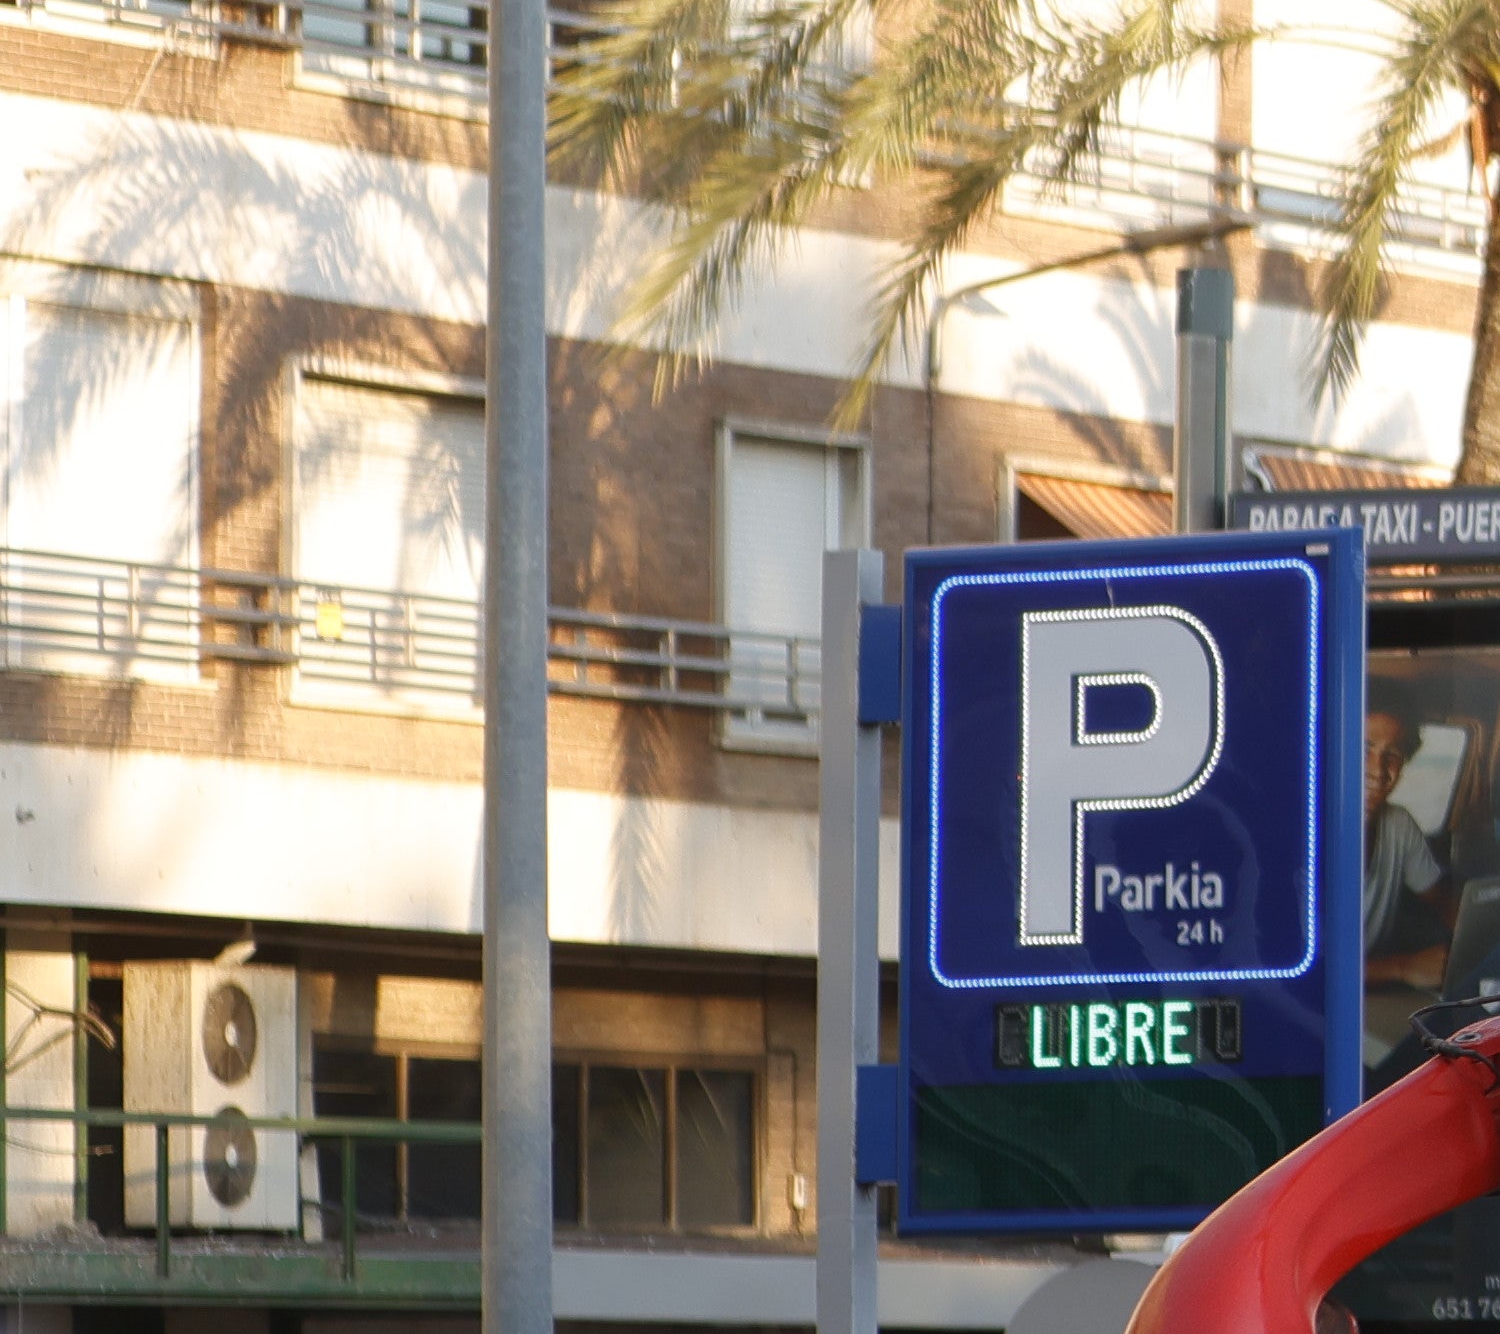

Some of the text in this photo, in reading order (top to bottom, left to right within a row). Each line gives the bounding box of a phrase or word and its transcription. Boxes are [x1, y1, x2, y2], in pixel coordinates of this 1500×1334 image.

[1361, 503, 1417, 544] TAXI
[1095, 862, 1224, 912] Parkia
[1177, 918, 1224, 946] 24 h
[1031, 1002, 1195, 1069] LIBRE
[1432, 1297, 1473, 1320] 651
